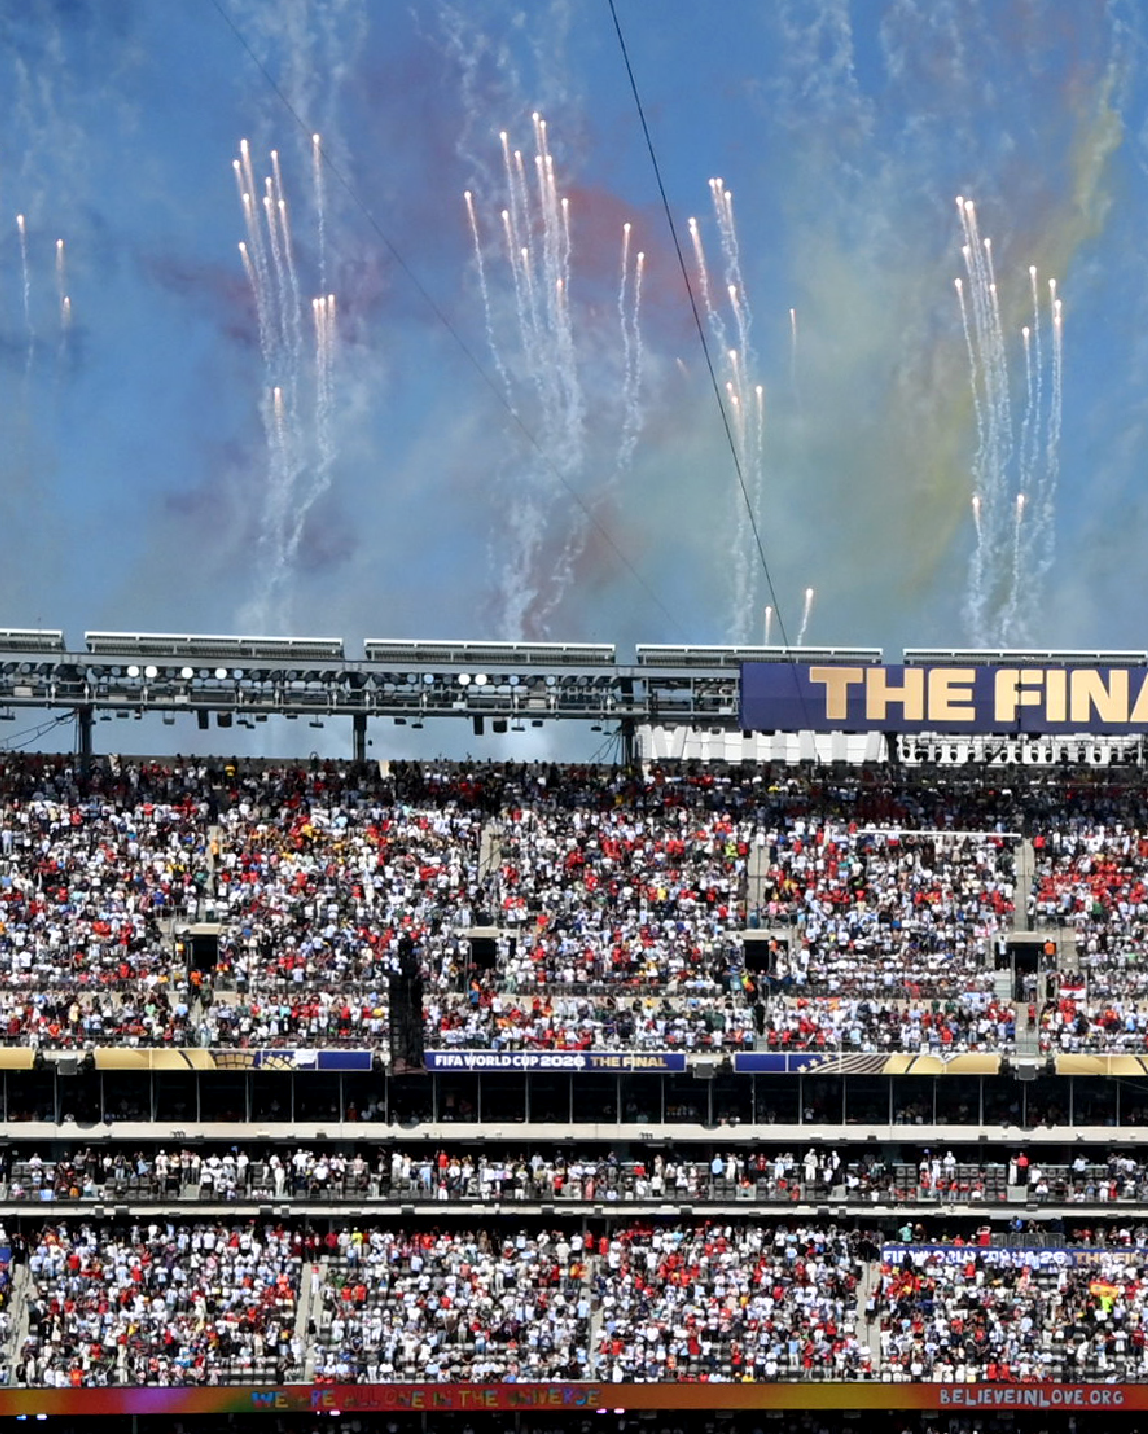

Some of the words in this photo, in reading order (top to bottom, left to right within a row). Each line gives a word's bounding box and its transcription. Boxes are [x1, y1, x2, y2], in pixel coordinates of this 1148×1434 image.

[809, 667, 976, 721] THE
[435, 1056, 463, 1066] FIFA
[464, 1056, 511, 1066] WORLD
[513, 1056, 538, 1067] CUP
[540, 1056, 586, 1067] 2026
[590, 1057, 620, 1067] THE
[622, 1057, 668, 1067] FINAL
[252, 1390, 289, 1409] WE
[384, 1390, 425, 1409] ONE
[433, 1390, 452, 1408] IN
[458, 1389, 499, 1408] THE
[508, 1388, 600, 1407] UNIVERSE
[940, 1388, 1125, 1408] BELIEVEINLOVE.ORG
